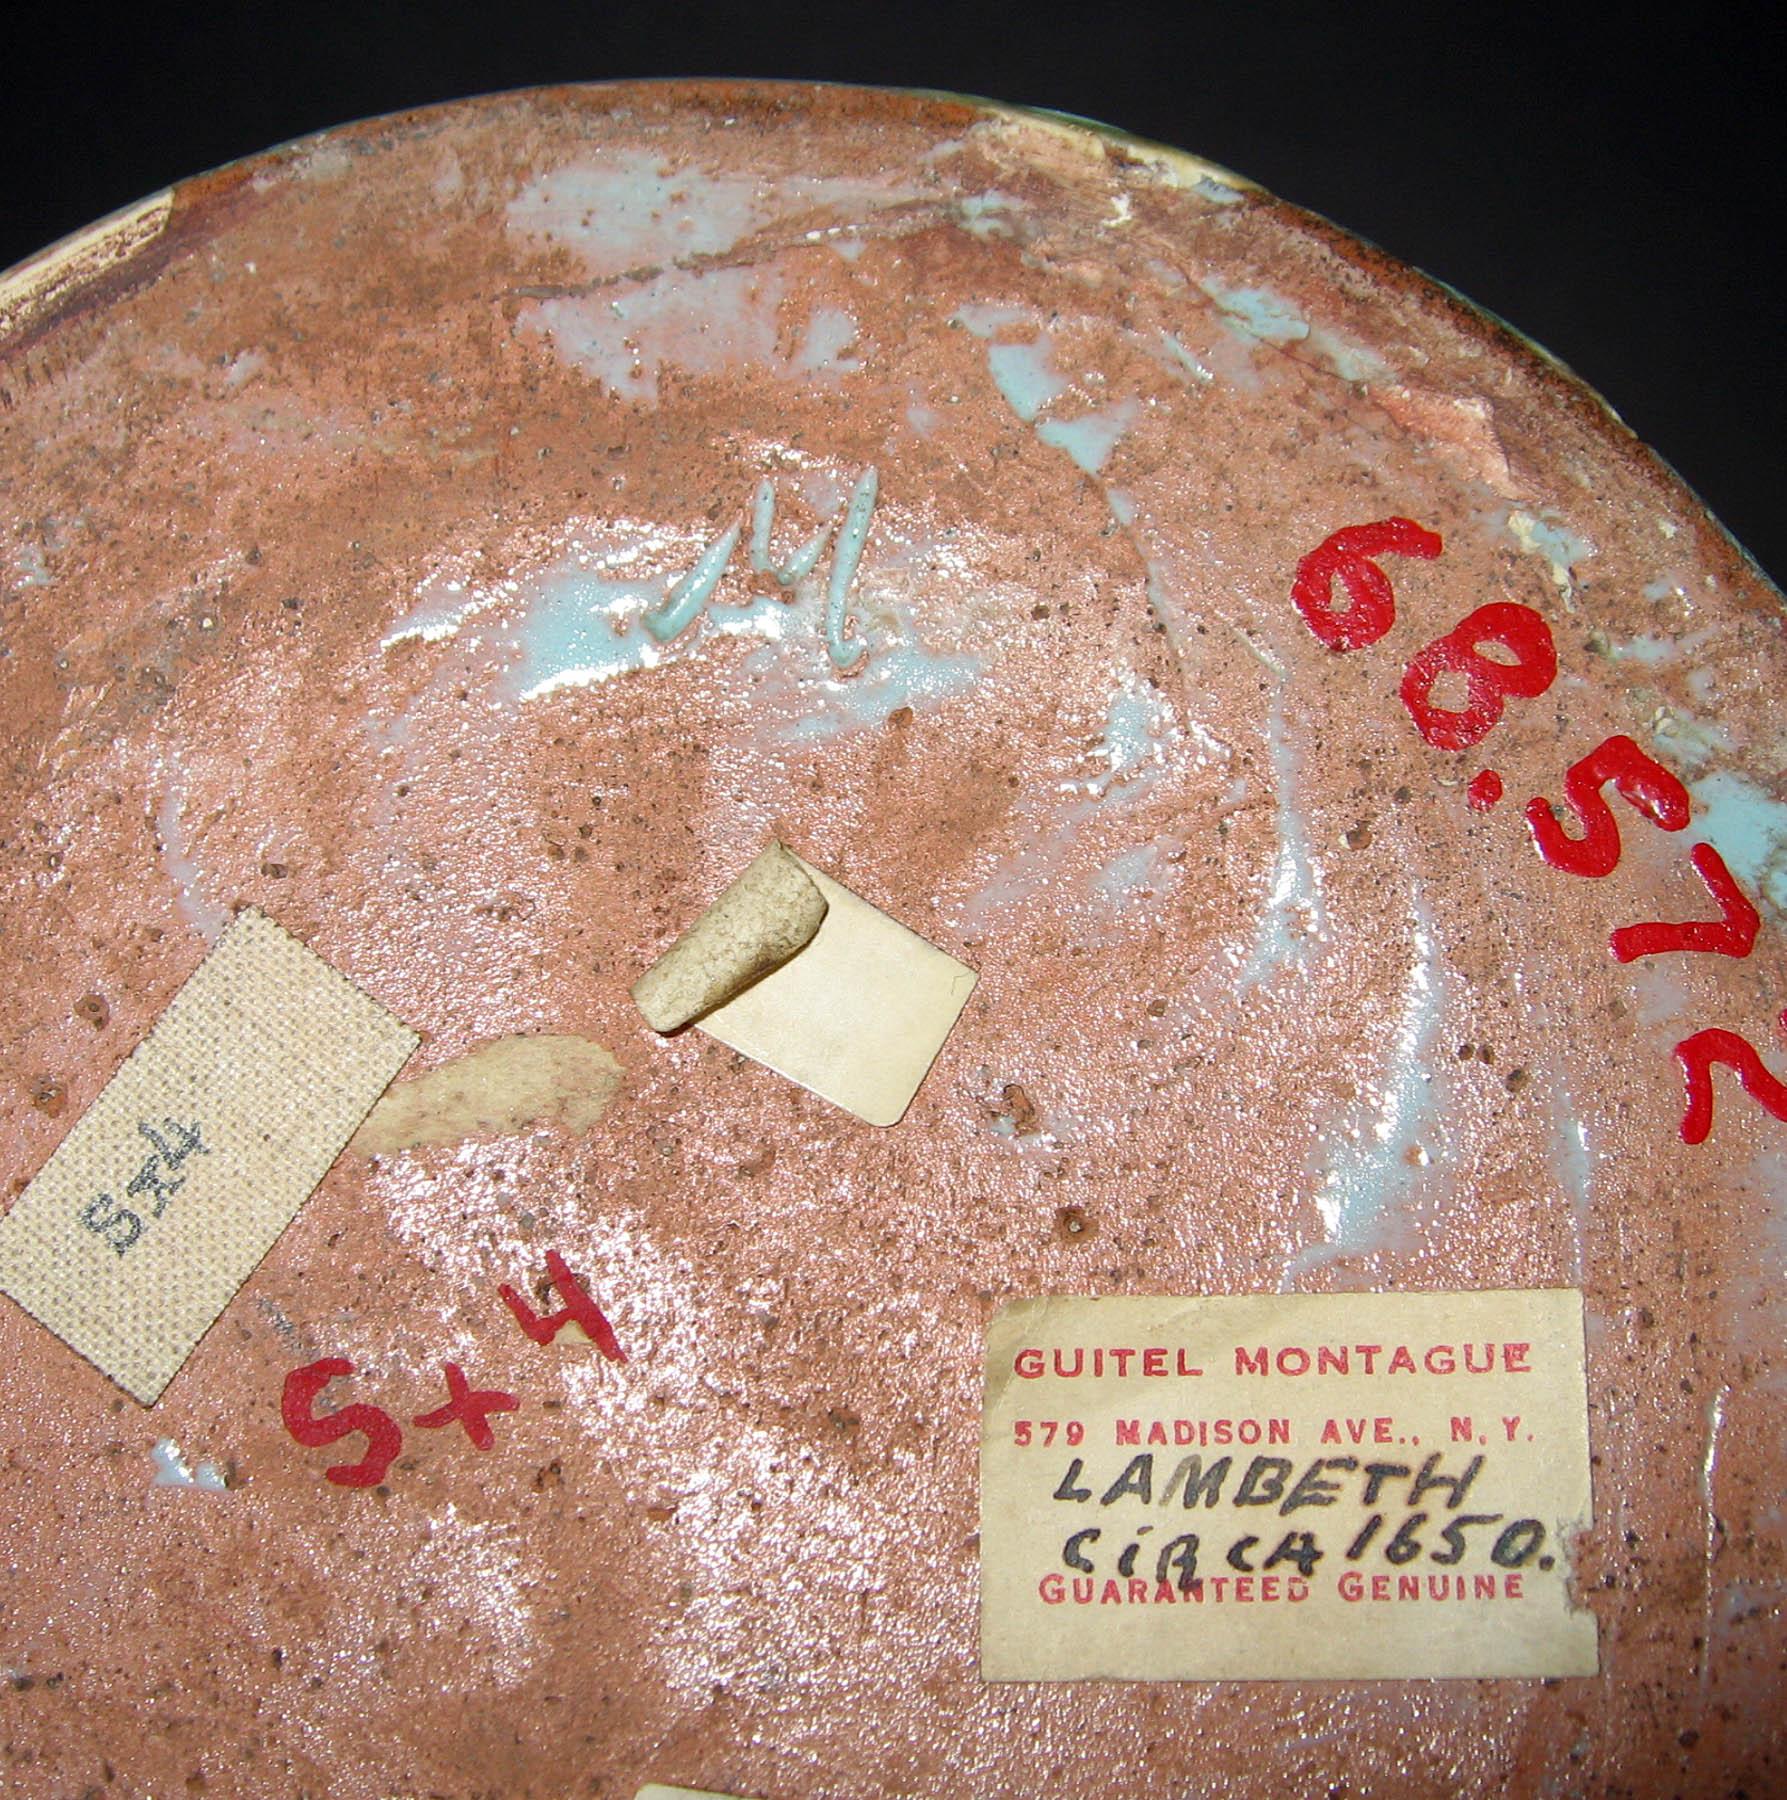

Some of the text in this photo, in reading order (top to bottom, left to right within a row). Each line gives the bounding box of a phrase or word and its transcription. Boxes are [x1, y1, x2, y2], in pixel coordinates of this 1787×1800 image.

[1013, 1343, 1532, 1379] GUITEL MONTAGUE
[1013, 1420, 1085, 1447] 579
[1115, 1418, 1290, 1447] MADISON
[1320, 1417, 1420, 1446] AVE.,
[1053, 1452, 1486, 1516] LAMBETH
[1346, 1512, 1556, 1571] 1650.
